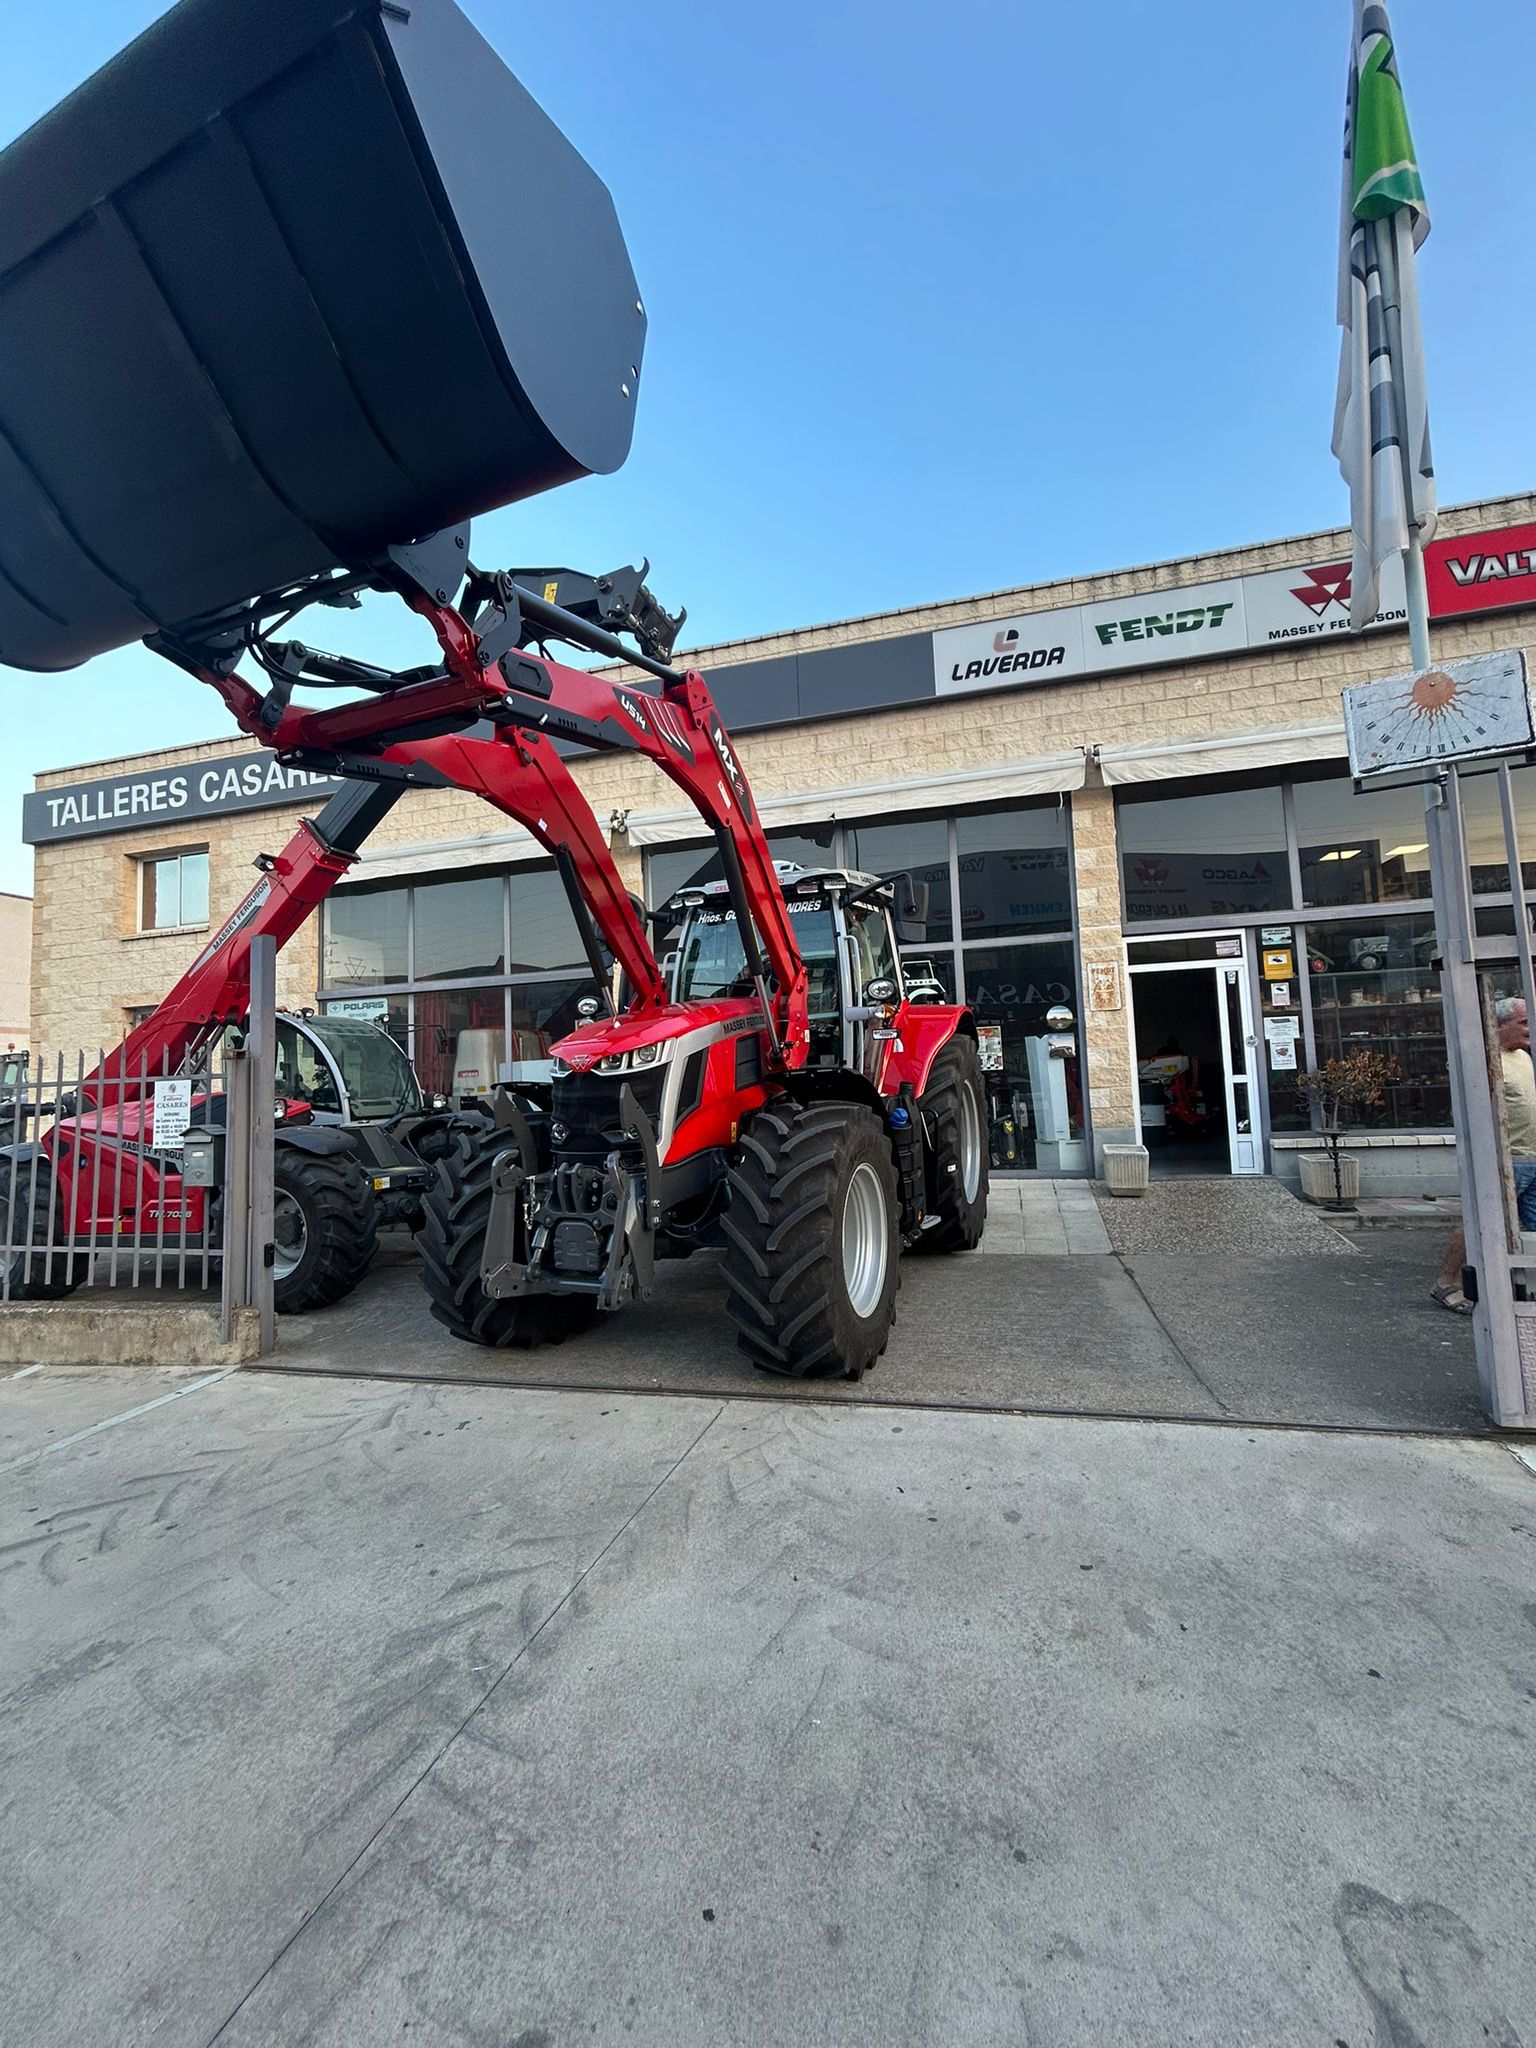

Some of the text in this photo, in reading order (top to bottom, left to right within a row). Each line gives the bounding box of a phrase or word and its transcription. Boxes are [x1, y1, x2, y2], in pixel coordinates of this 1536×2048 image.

[1094, 603, 1234, 645] FENDT
[1268, 609, 1406, 640] MASSEY FESON
[952, 646, 1065, 681] LAVERDA
[46, 760, 346, 828] TALLERES CASAR
[212, 880, 269, 951] MASSEY FERGUSON
[697, 912, 723, 924] Hnos.
[786, 897, 822, 914] NDRÉS
[343, 1000, 385, 1011] POLARIS
[156, 1101, 189, 1109] CASARES
